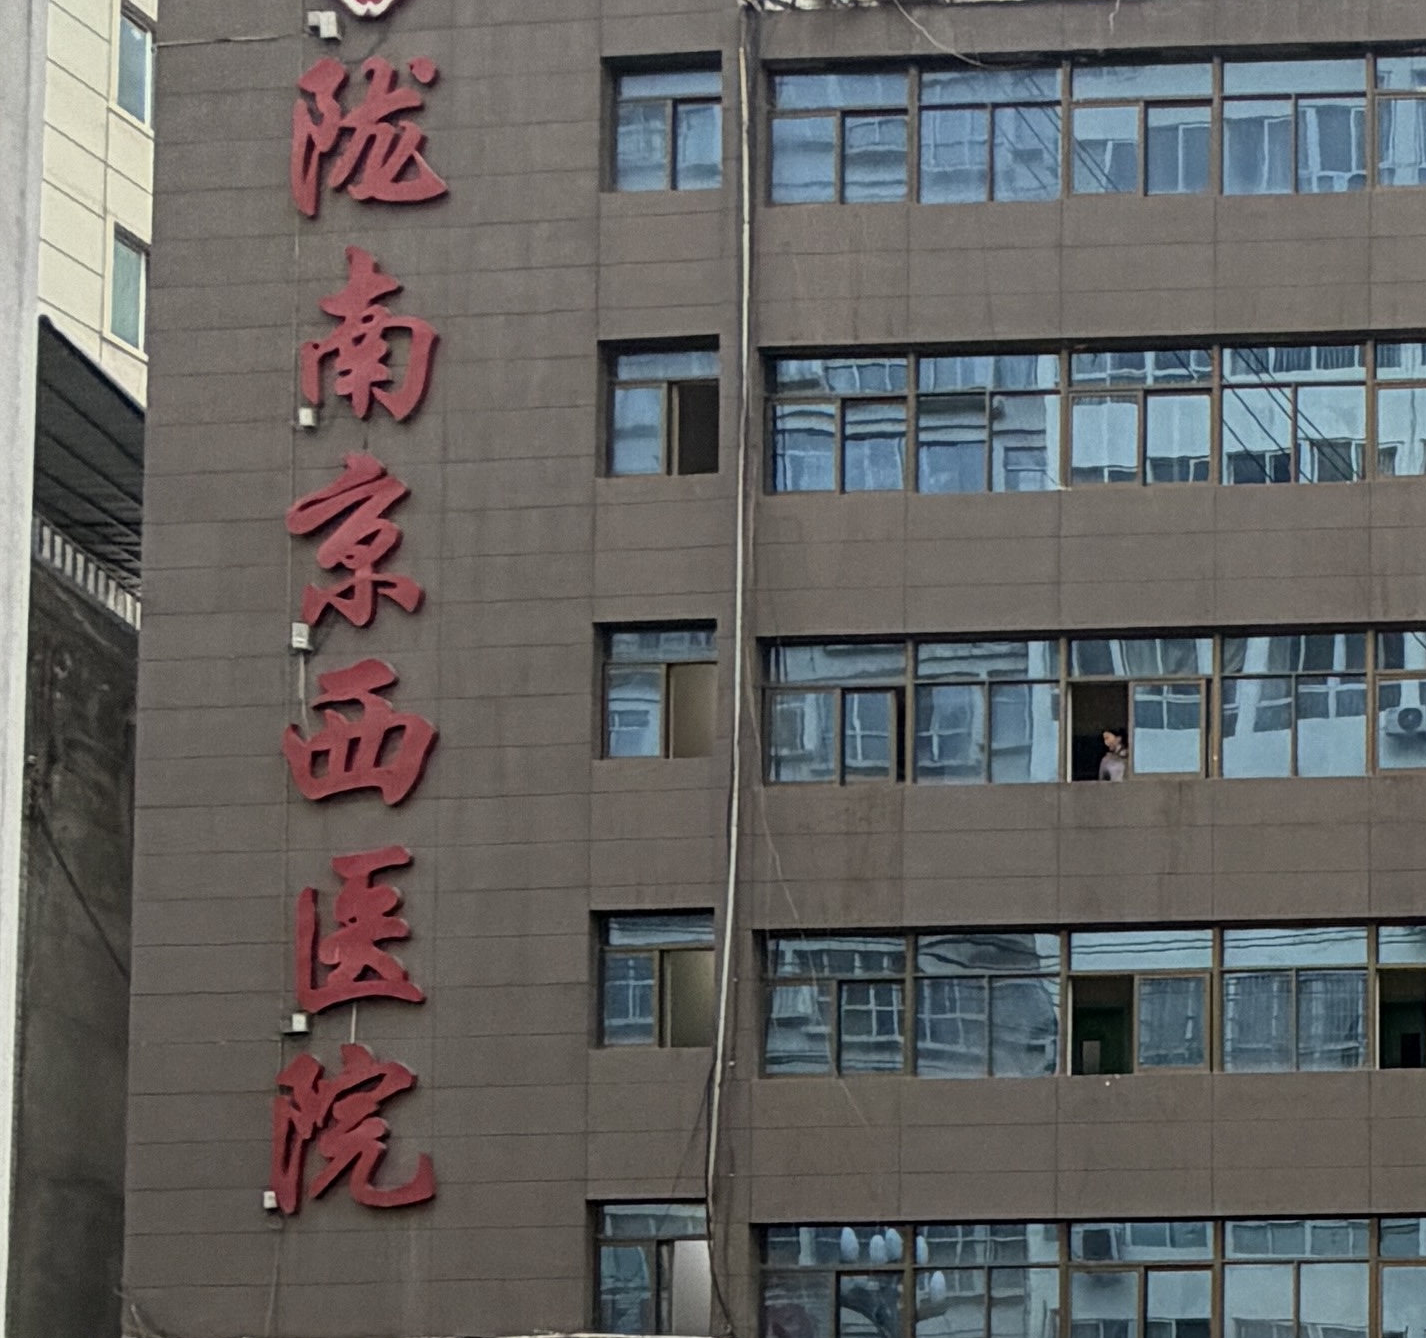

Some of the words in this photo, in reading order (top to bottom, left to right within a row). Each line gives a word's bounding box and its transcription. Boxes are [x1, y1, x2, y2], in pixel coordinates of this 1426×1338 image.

[271, 56, 448, 1215] 陇南京西医院
